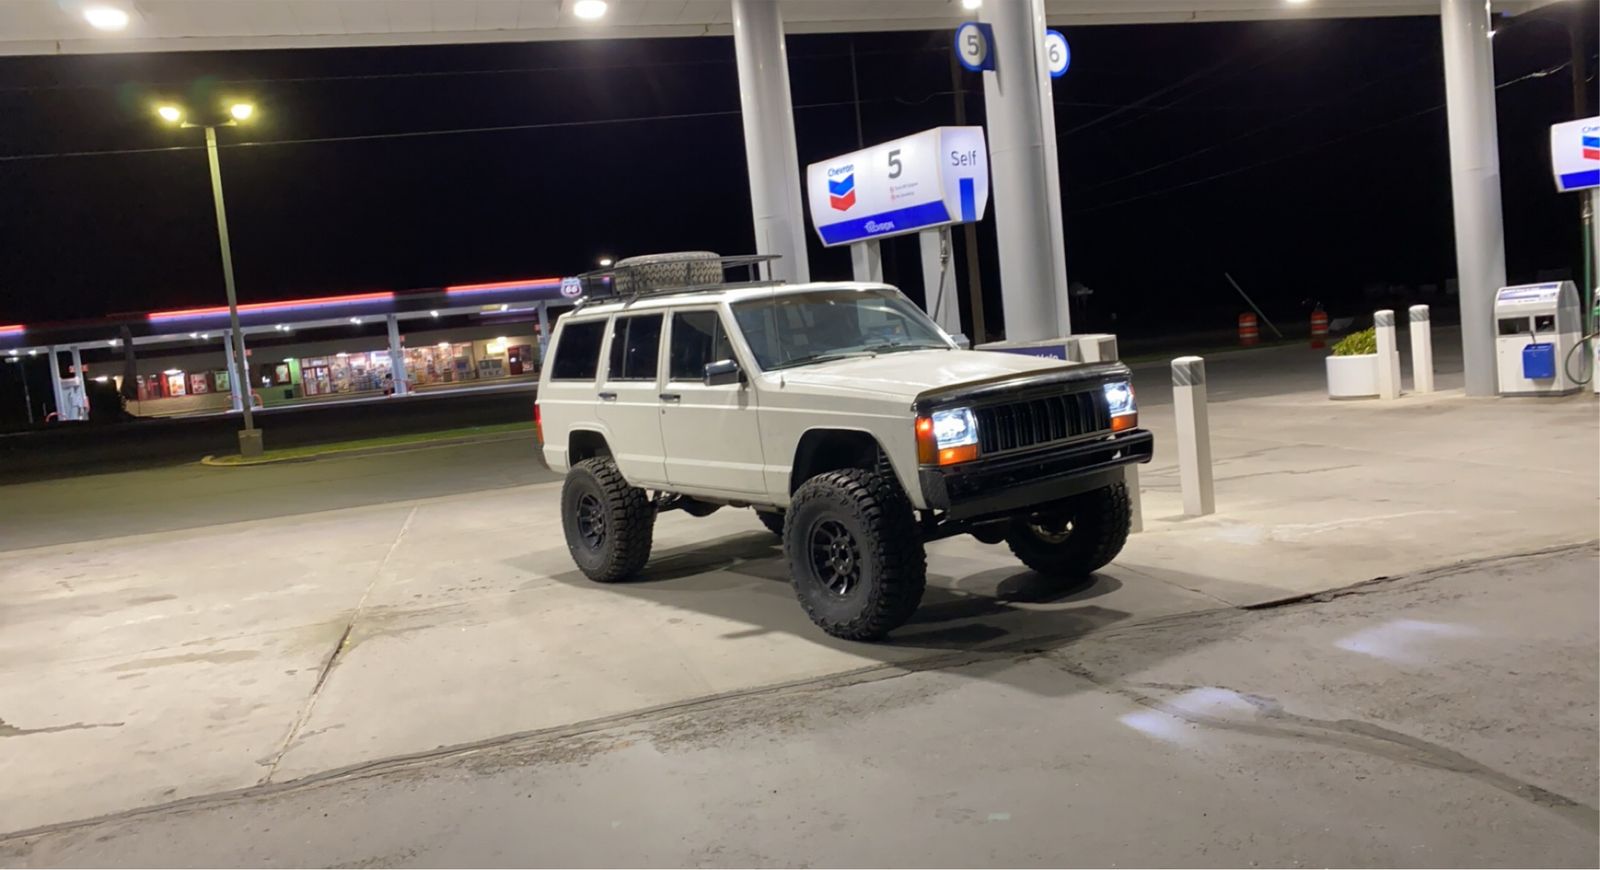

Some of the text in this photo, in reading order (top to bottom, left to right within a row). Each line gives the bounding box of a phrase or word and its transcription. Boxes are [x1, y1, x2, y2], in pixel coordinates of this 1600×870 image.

[967, 35, 979, 56] 5
[1049, 44, 1060, 63] 6
[888, 149, 902, 179] 5
[951, 150, 977, 166] Self
[565, 285, 578, 293] 66
